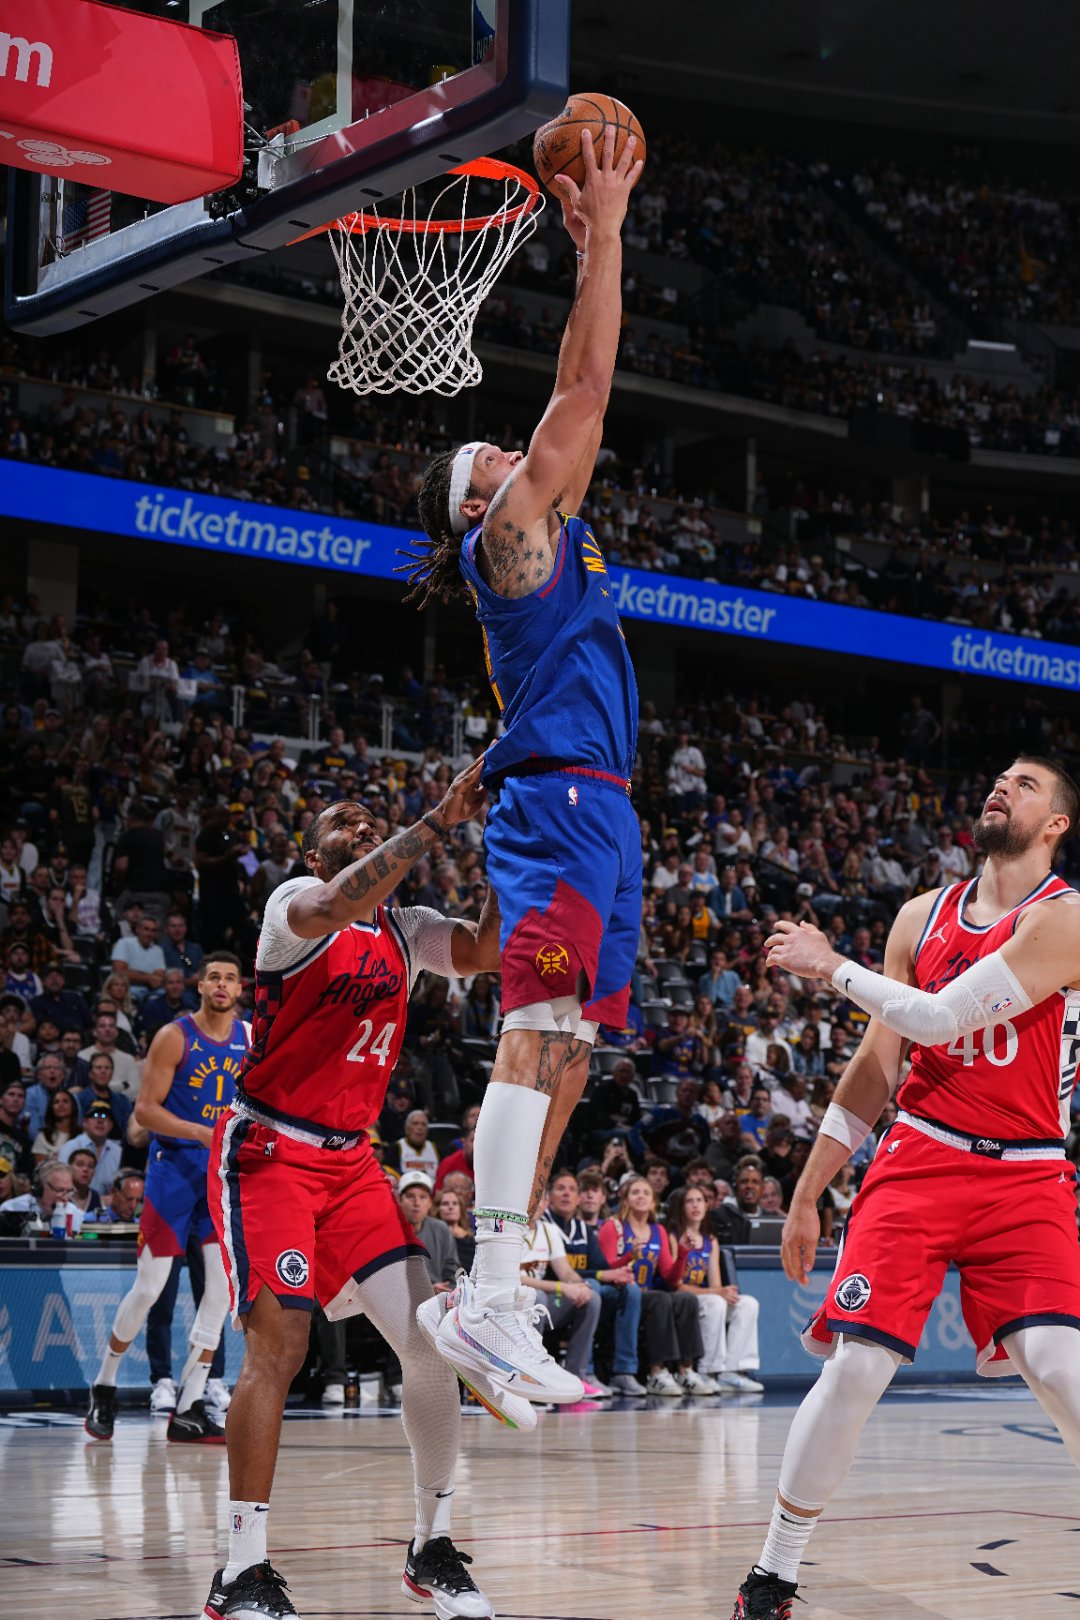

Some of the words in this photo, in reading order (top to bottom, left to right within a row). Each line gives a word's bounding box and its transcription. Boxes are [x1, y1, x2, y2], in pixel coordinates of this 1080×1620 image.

[135, 493, 371, 567] ticketmaster
[952, 632, 1080, 686] ticketmas
[355, 951, 391, 979] Los
[346, 1019, 397, 1066] 24
[947, 1019, 1019, 1067] 40
[189, 1056, 218, 1088] MILE
[216, 1075, 224, 1102] 1
[976, 1139, 1003, 1151] Clips
